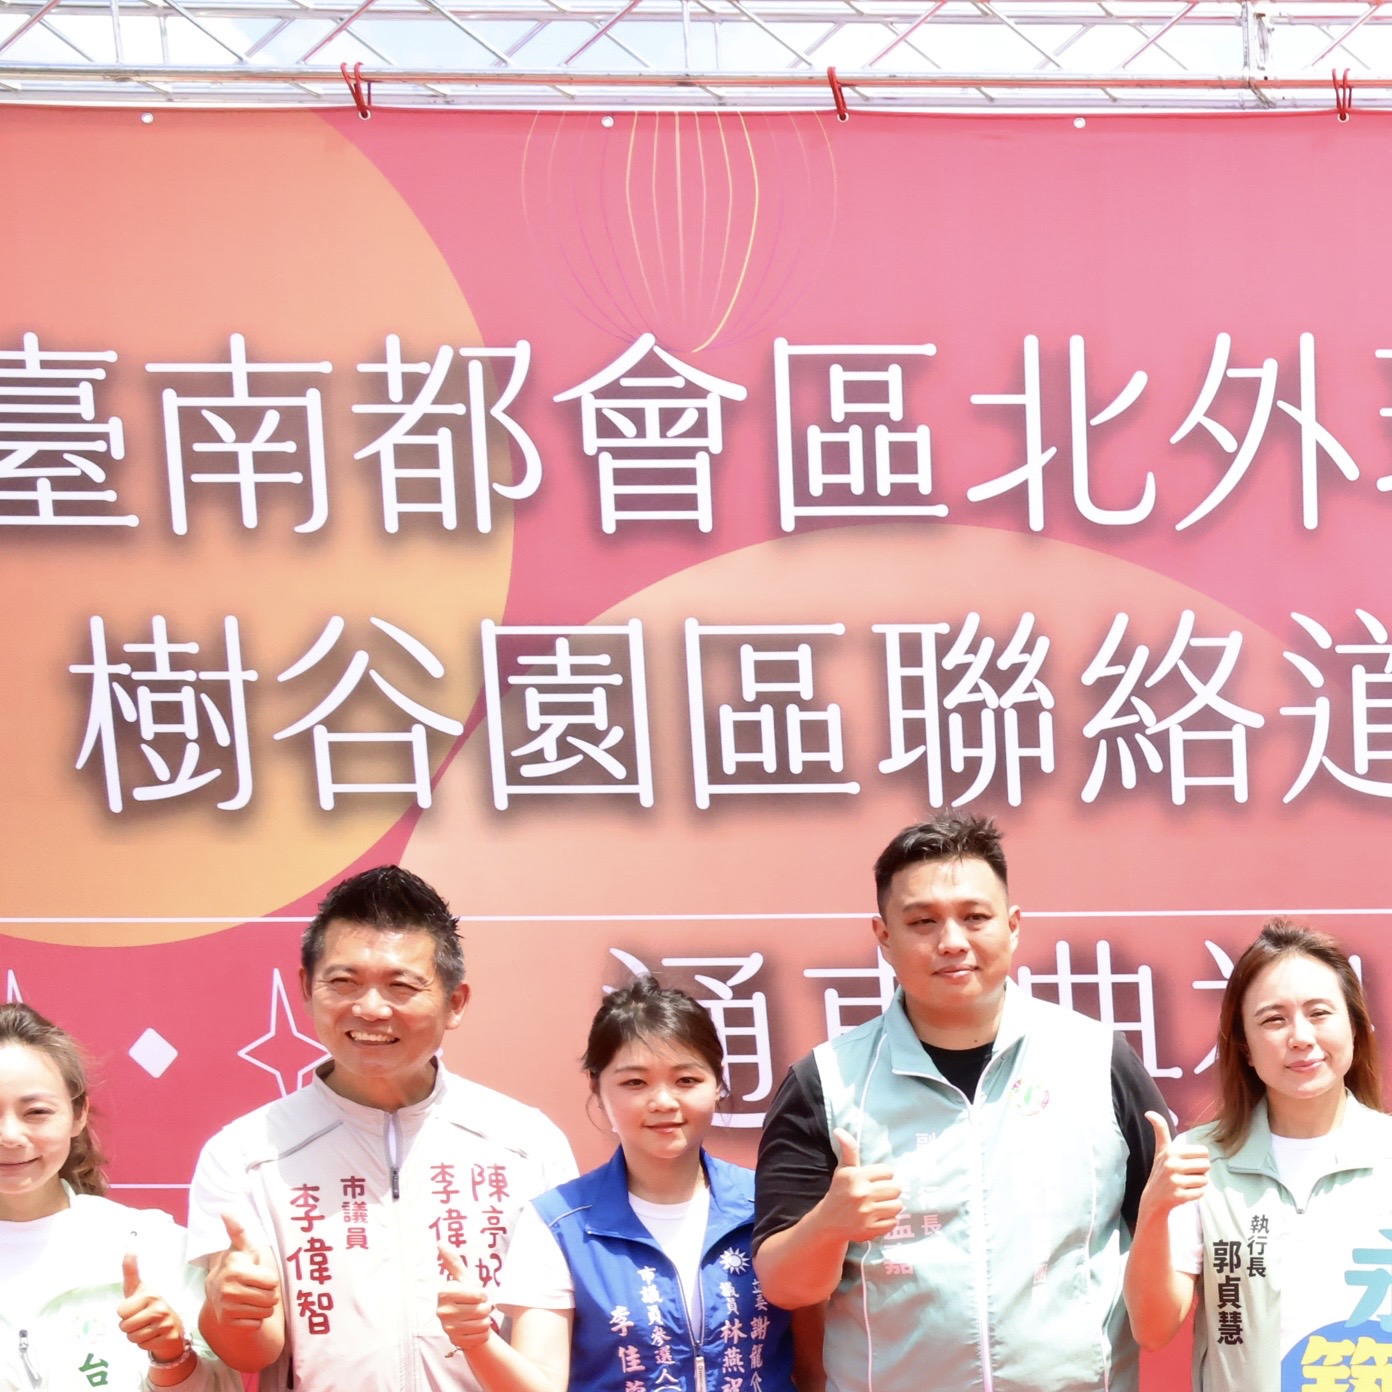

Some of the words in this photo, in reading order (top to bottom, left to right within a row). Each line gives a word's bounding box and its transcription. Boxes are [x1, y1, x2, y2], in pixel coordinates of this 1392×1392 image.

[286, 1183, 334, 1335] 李偉智
[340, 1175, 369, 1250] 市議員
[470, 1162, 511, 1288] 陳亭妃
[1246, 1214, 1270, 1278] 執行長
[1212, 1239, 1244, 1345] 郭貞慧
